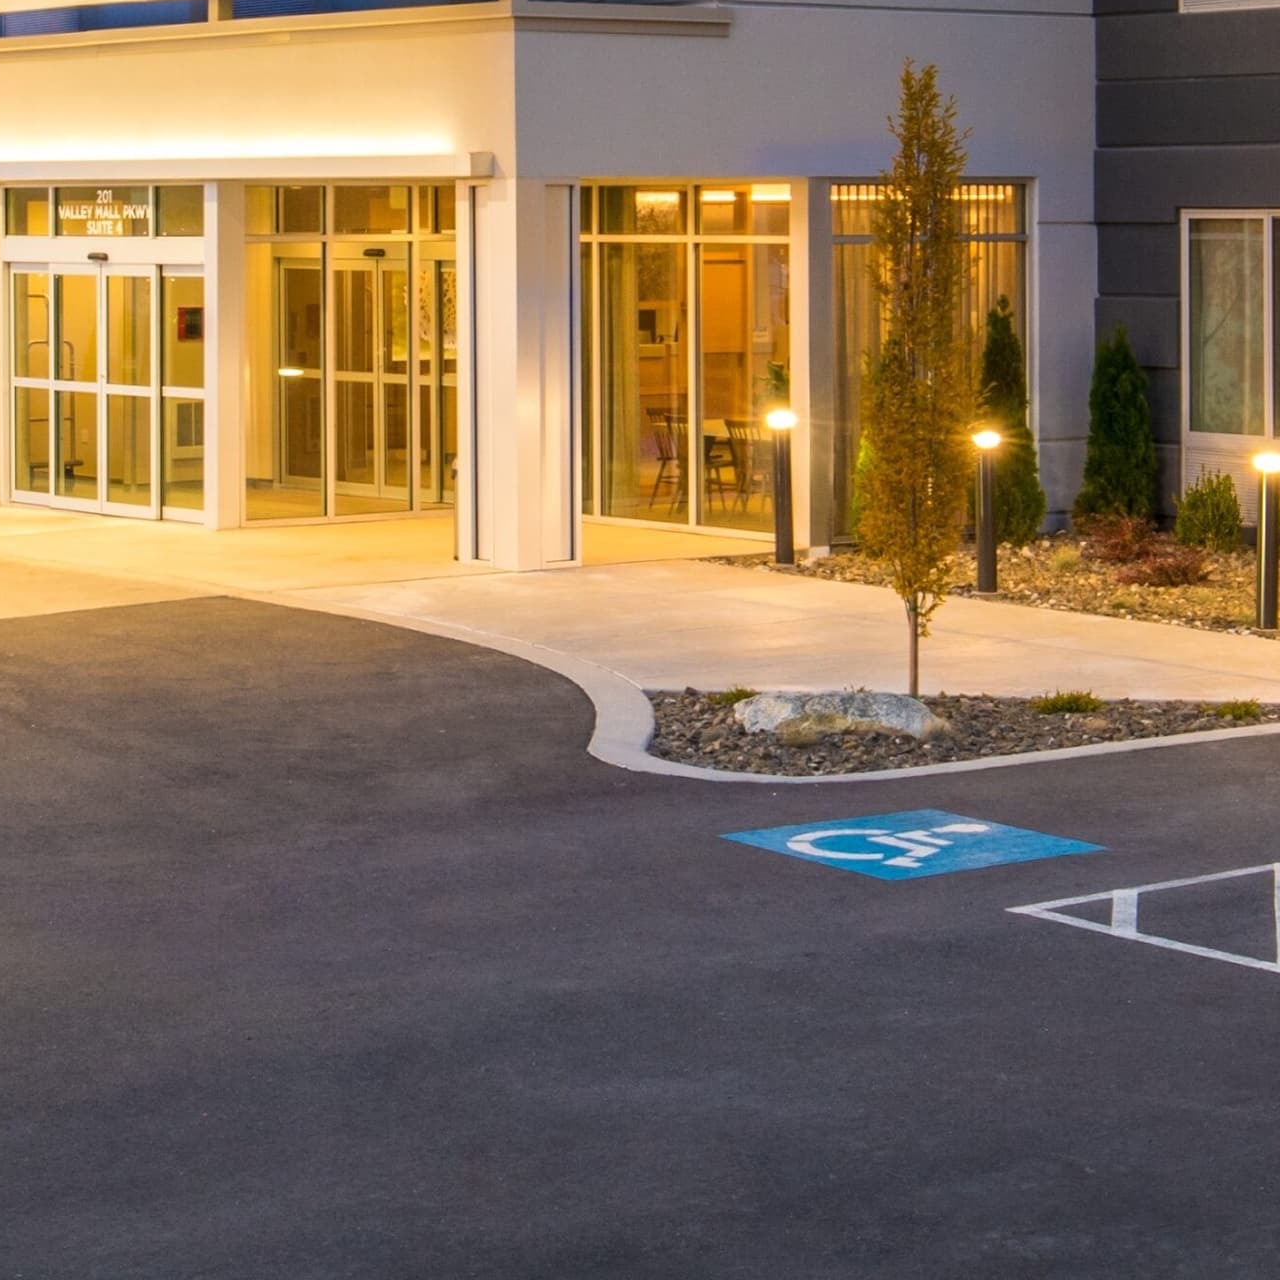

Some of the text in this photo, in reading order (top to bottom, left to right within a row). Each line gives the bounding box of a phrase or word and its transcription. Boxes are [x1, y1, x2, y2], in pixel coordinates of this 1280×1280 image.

[96, 189, 113, 204] 201
[58, 204, 93, 219] VALLEY
[95, 204, 121, 219] MALL
[86, 220, 123, 235] SUITE 4
